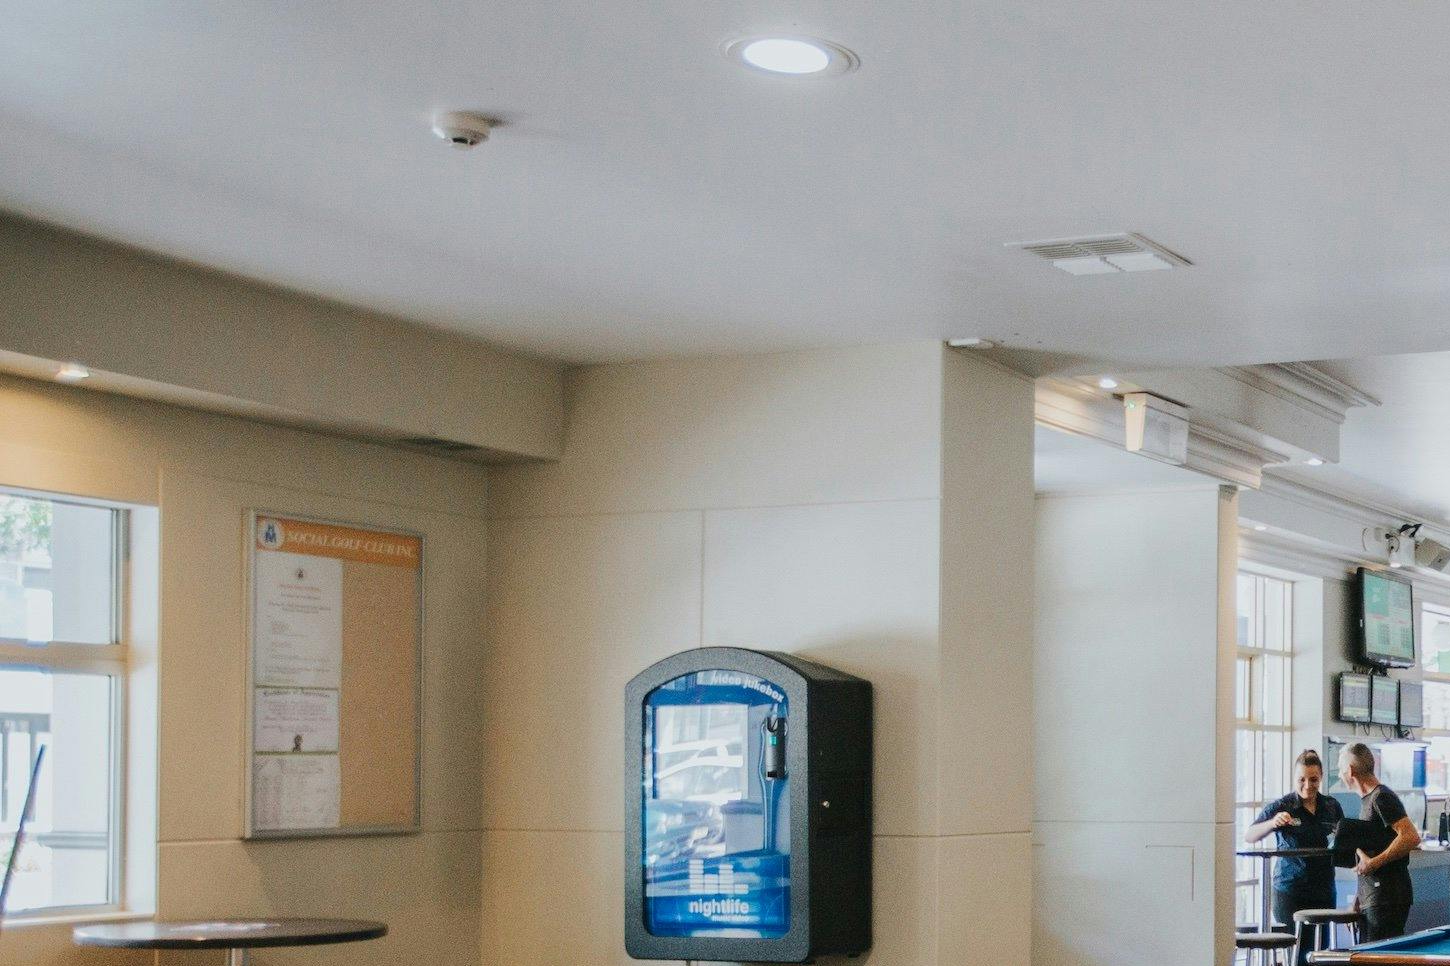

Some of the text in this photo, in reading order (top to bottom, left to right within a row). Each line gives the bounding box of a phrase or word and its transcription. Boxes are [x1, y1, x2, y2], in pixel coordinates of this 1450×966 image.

[288, 529, 327, 547] SOCIAL
[331, 535, 361, 551] GOLF
[364, 539, 394, 555] CLUB
[743, 676, 785, 703] jukebox
[688, 898, 749, 917] nightlife
